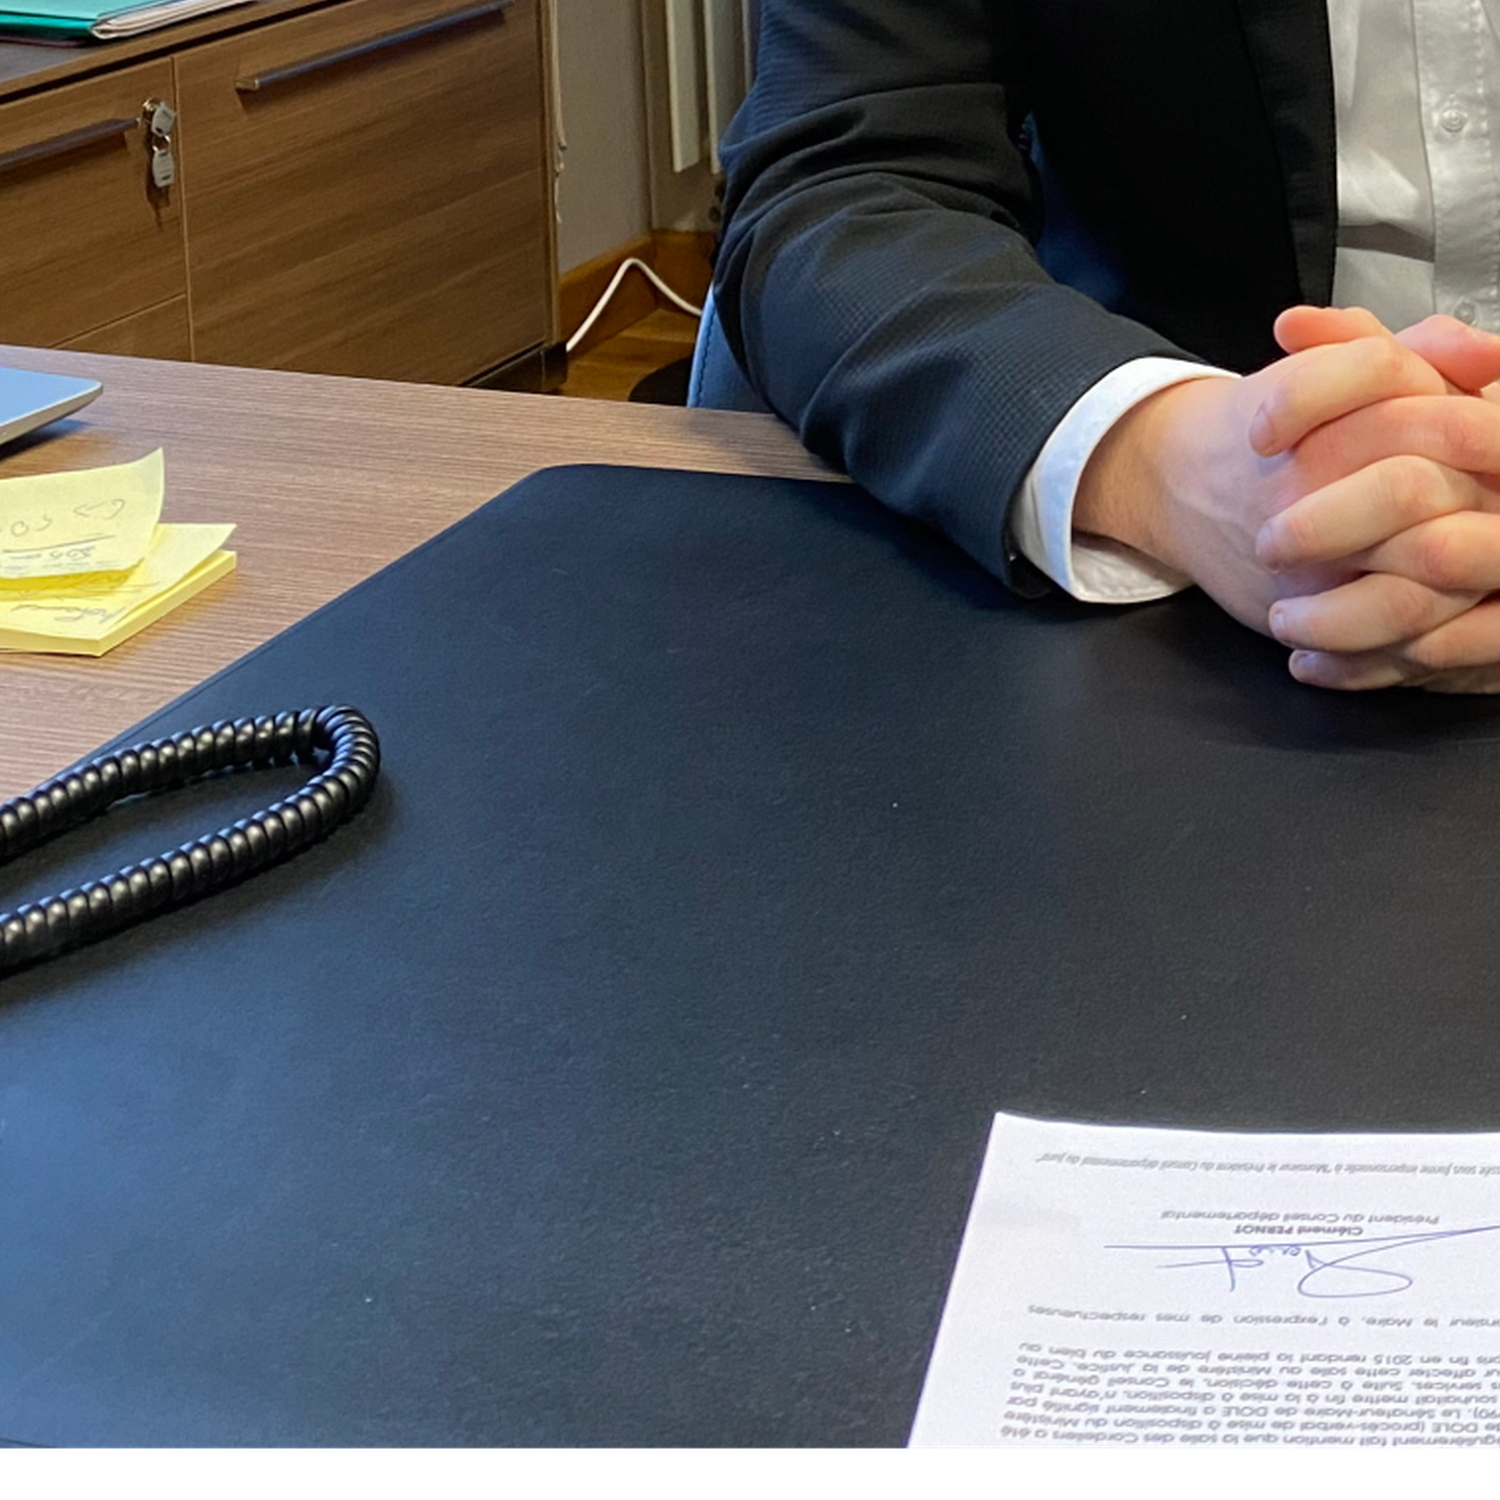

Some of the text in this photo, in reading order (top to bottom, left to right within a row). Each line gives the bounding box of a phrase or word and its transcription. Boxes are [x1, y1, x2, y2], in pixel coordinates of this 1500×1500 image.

[1162, 1209, 1440, 1225] Président du Conseil départemental
[1234, 1225, 1364, 1237] Clément PERNOT
[1029, 1306, 1146, 1322] respectueuses
[1156, 1313, 1191, 1323] mes
[1200, 1314, 1224, 1325] de
[1338, 1316, 1351, 1327] à
[1423, 1317, 1439, 1328] le
[1019, 1343, 1043, 1354] au
[1048, 1346, 1087, 1359] bien
[1092, 1349, 1117, 1361] du
[1123, 1350, 1212, 1363] jouissance
[1217, 1351, 1271, 1364] pleine
[1276, 1353, 1294, 1364] la
[1299, 1353, 1368, 1364] rendant
[1373, 1354, 1413, 1365] 2015
[1419, 1354, 1443, 1363] en
[1448, 1354, 1470, 1366] fin
[1017, 1357, 1066, 1372] Cette
[1142, 1364, 1159, 1375] la
[1166, 1364, 1191, 1376] de
[1013, 1369, 1026, 1378] a
[1197, 1365, 1273, 1377] Ministère
[1279, 1366, 1303, 1375] au
[1310, 1366, 1348, 1378] salle
[1354, 1367, 1402, 1378] cette
[1408, 1367, 1477, 1379] affecter
[1033, 1370, 1101, 1386] général
[1107, 1376, 1171, 1389] Conseil
[1179, 1378, 1195, 1389] le
[1011, 1382, 1045, 1395] plus
[1286, 1380, 1333, 1391] cette
[1340, 1380, 1354, 1391] à
[1362, 1380, 1403, 1392] Suite
[1006, 1397, 1038, 1408] par
[1221, 1392, 1235, 1403] à
[1239, 1392, 1280, 1404] mise
[1284, 1393, 1302, 1404] la
[1306, 1393, 1320, 1405] à
[1325, 1394, 1347, 1405] fin
[1352, 1394, 1410, 1405] mettre
[1415, 1394, 1498, 1406] souhaitait
[1042, 1400, 1100, 1414] signifié
[1105, 1403, 1198, 1416] finalement
[1203, 1406, 1217, 1415] a
[1223, 1406, 1269, 1417] DOLE
[1274, 1407, 1299, 1418] de
[1441, 1408, 1462, 1419] Le
[1004, 1412, 1081, 1428] Ministère
[1084, 1417, 1109, 1429] du
[1113, 1417, 1204, 1431] disposition
[1208, 1420, 1222, 1431] à
[1226, 1420, 1267, 1431] mise
[1270, 1421, 1296, 1432] de
[1432, 1422, 1479, 1433] DOLE
[1001, 1427, 1031, 1440] été
[1034, 1429, 1048, 1439] a
[1053, 1430, 1139, 1444] Cordeliers
[1143, 1433, 1176, 1444] des
[1179, 1433, 1218, 1445] salle
[1243, 1432, 1279, 1443] que
[1222, 1434, 1239, 1445] la
[1283, 1434, 1356, 1446] mention
[1359, 1436, 1388, 1447] fait
